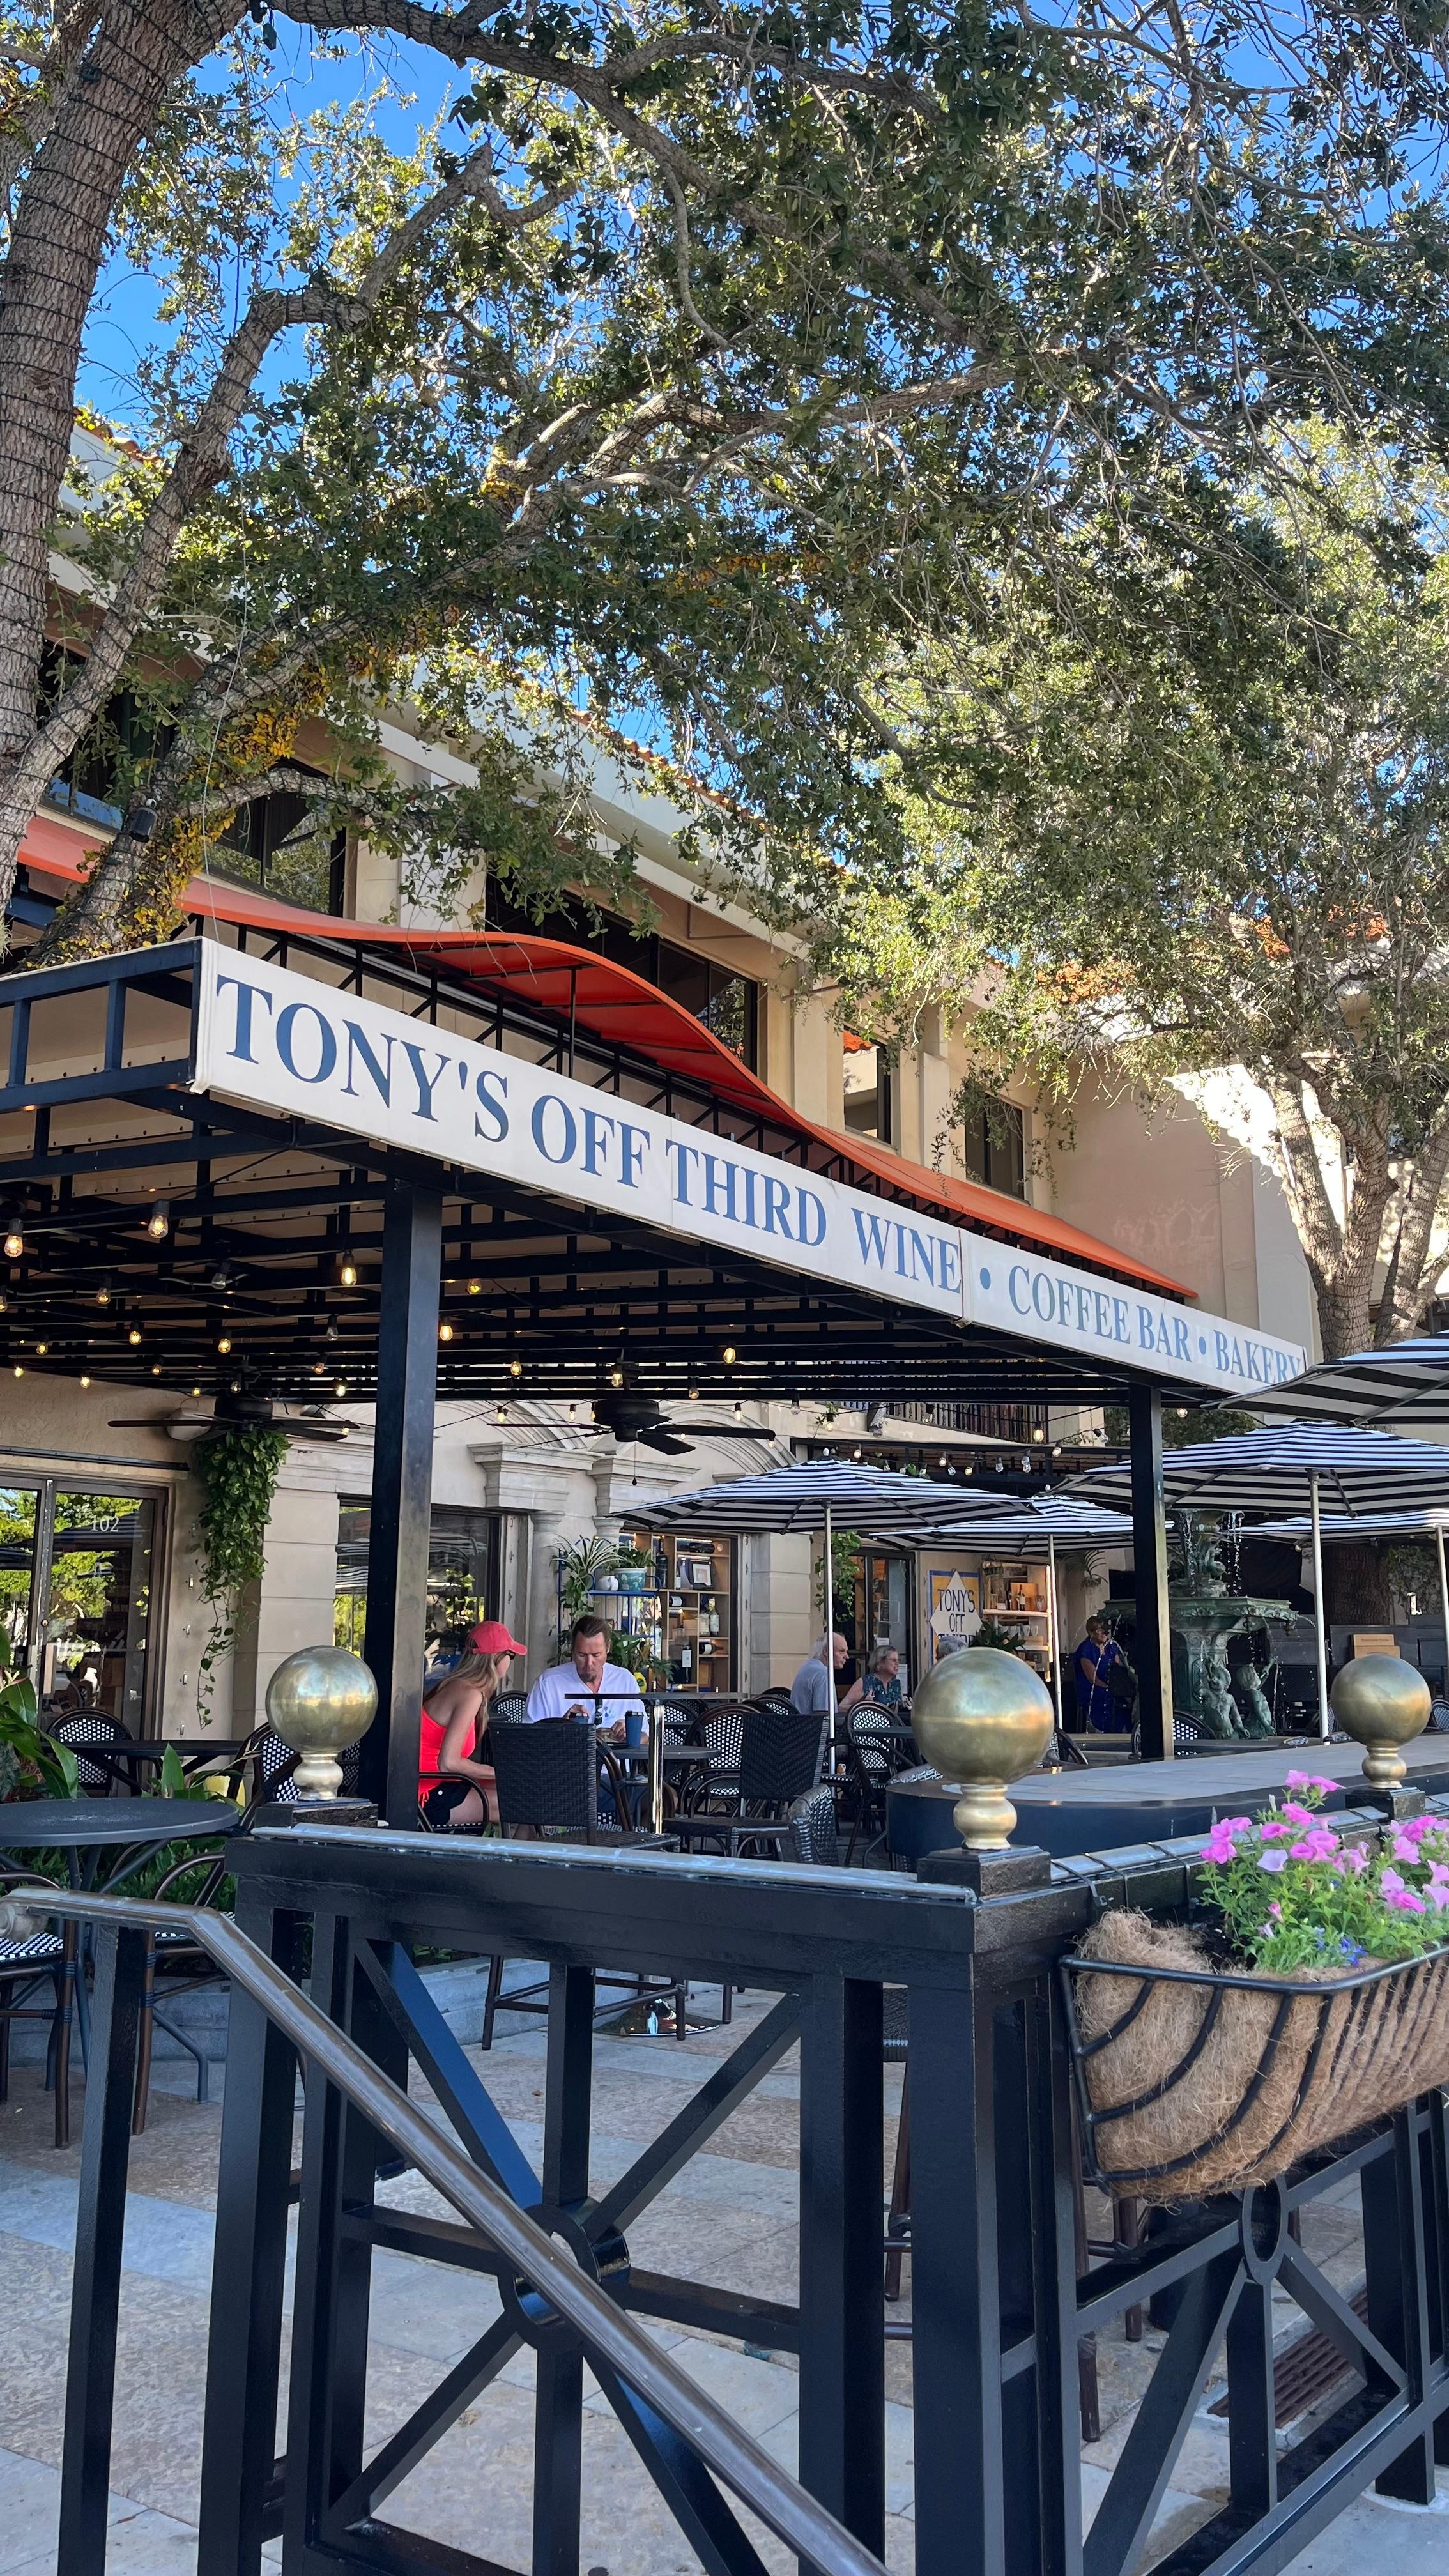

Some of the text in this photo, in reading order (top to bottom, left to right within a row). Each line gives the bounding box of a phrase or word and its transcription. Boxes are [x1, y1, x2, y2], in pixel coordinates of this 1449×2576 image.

[217, 974, 1301, 1384] TONY'S OFF THIRD WINE COFFEE BAR BAKERY
[91, 1515, 119, 1532] 102
[949, 1613, 965, 1632] OFF
